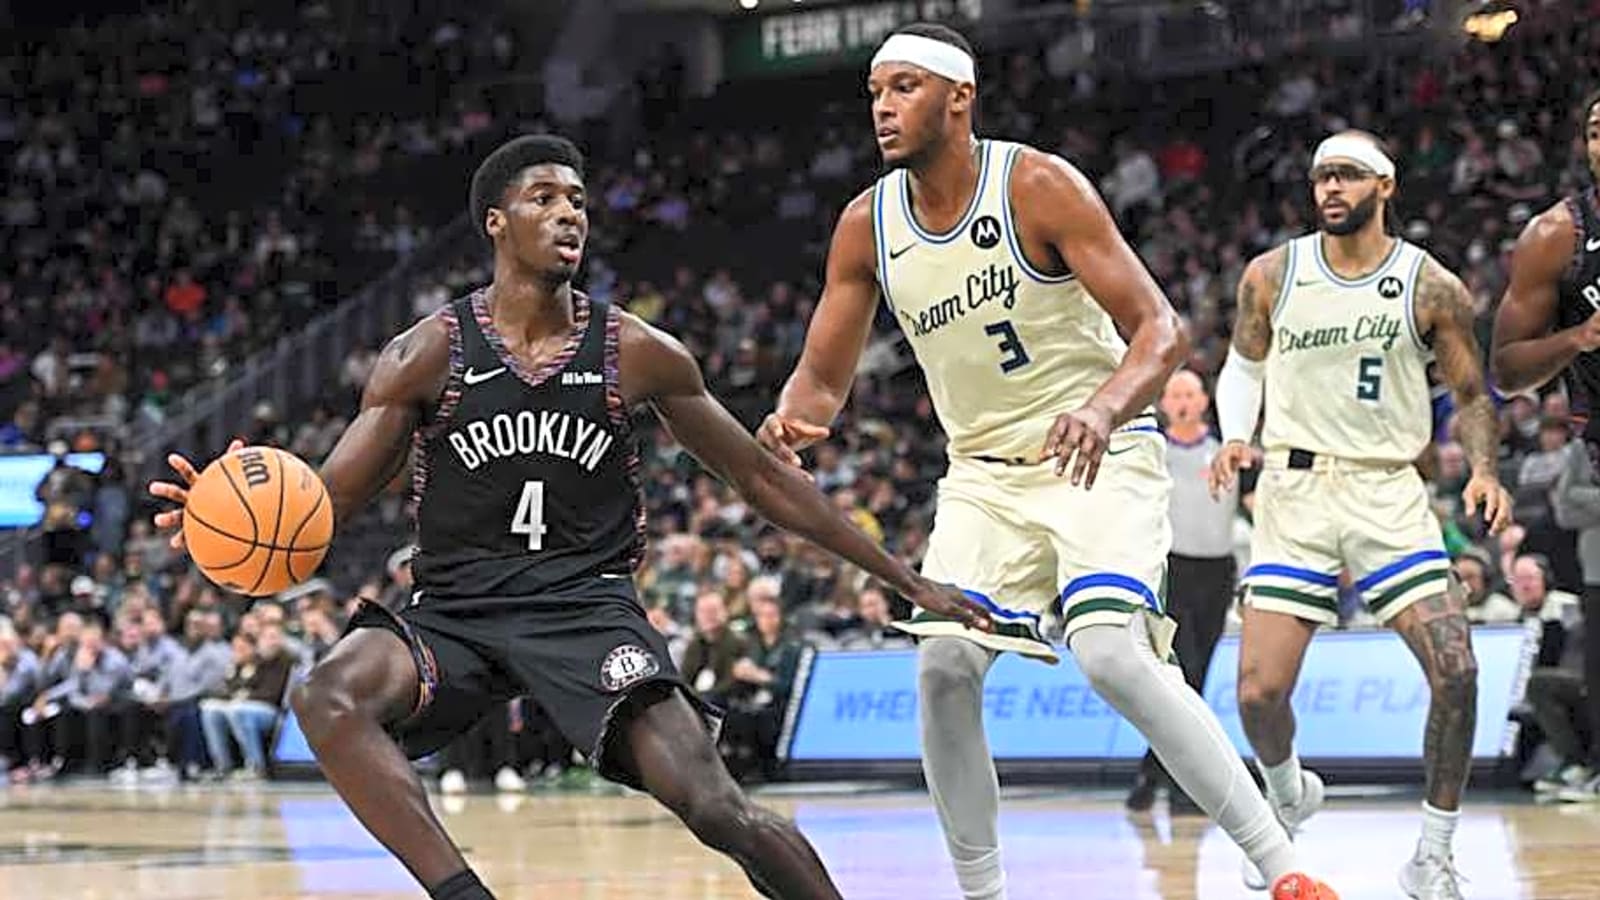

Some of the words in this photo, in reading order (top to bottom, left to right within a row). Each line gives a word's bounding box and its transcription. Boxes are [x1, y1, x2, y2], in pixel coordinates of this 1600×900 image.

[901, 295, 965, 336] ream
[966, 264, 1020, 309] City
[984, 320, 1031, 374] 3
[1278, 326, 1348, 354] Cream
[1354, 314, 1402, 351] City
[1357, 357, 1383, 401] 5
[449, 411, 613, 471] BROOKLYN
[511, 481, 547, 551] 4
[834, 690, 917, 720] WHE
[1025, 684, 1111, 719] NEE
